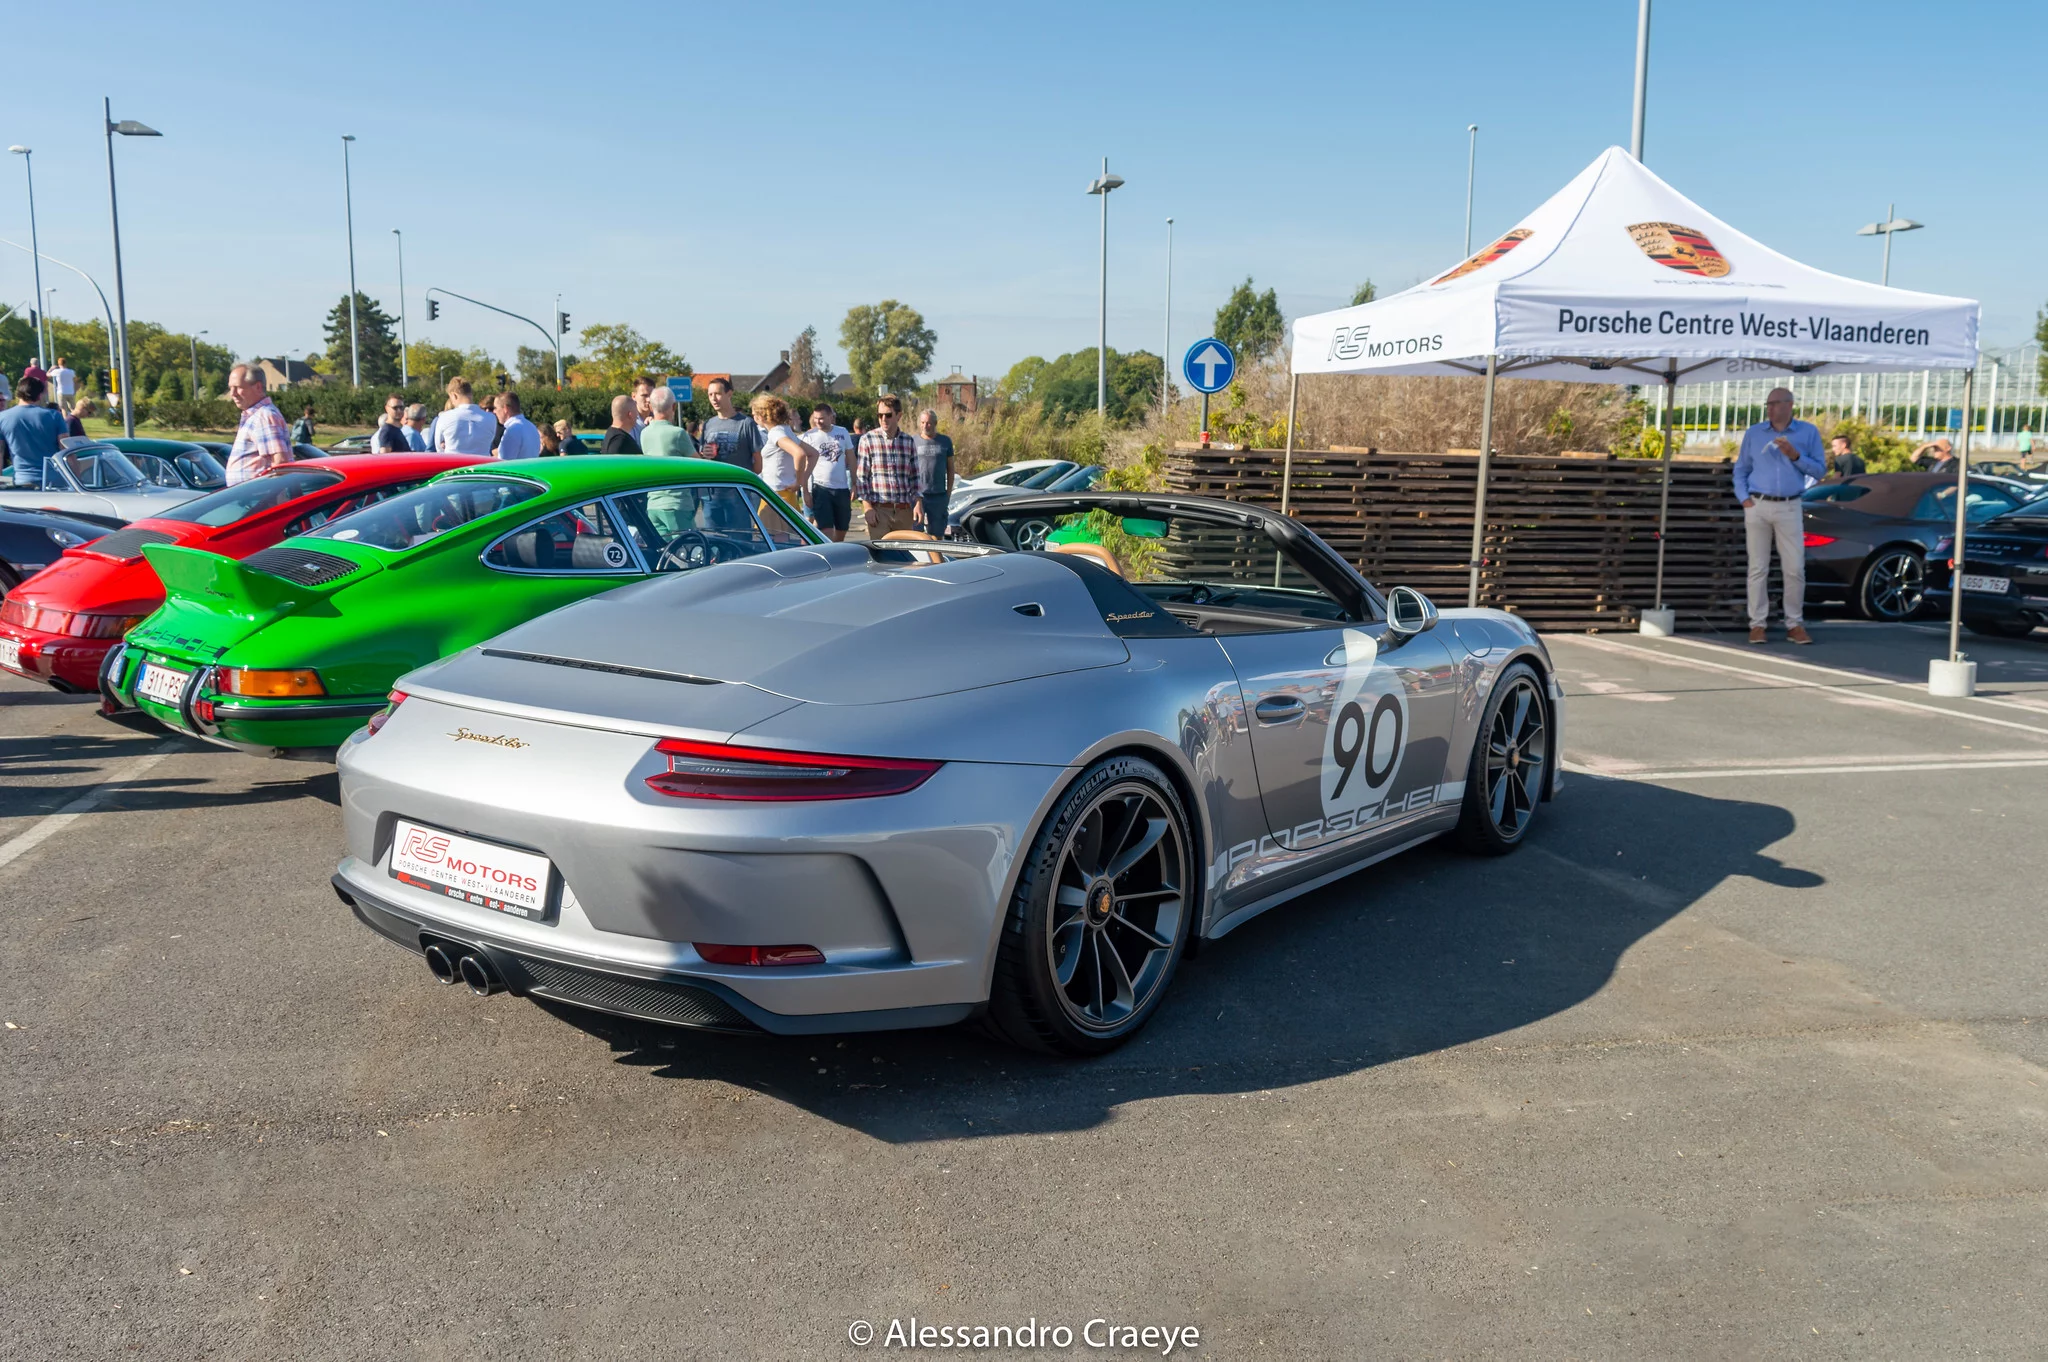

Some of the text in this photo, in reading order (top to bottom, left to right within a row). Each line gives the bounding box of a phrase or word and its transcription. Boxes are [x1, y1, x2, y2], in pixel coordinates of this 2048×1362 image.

[1327, 325, 1443, 362] RS MOTORS
[1558, 309, 1929, 346] Porsche Centre West-Vlaanderen
[609, 550, 622, 559] 72
[1106, 611, 1155, 623] Speedster
[446, 727, 530, 749] Speedster
[1330, 693, 1404, 800] 90
[1062, 767, 1109, 822] MICHELIN
[1228, 787, 1436, 871] PORSCHE
[401, 828, 538, 892] RS MOTORS
[398, 859, 537, 905] PORSCHE CENTRE WEST-VLAANDEREN
[444, 885, 466, 900] Porsche
[465, 891, 484, 906] Centre
